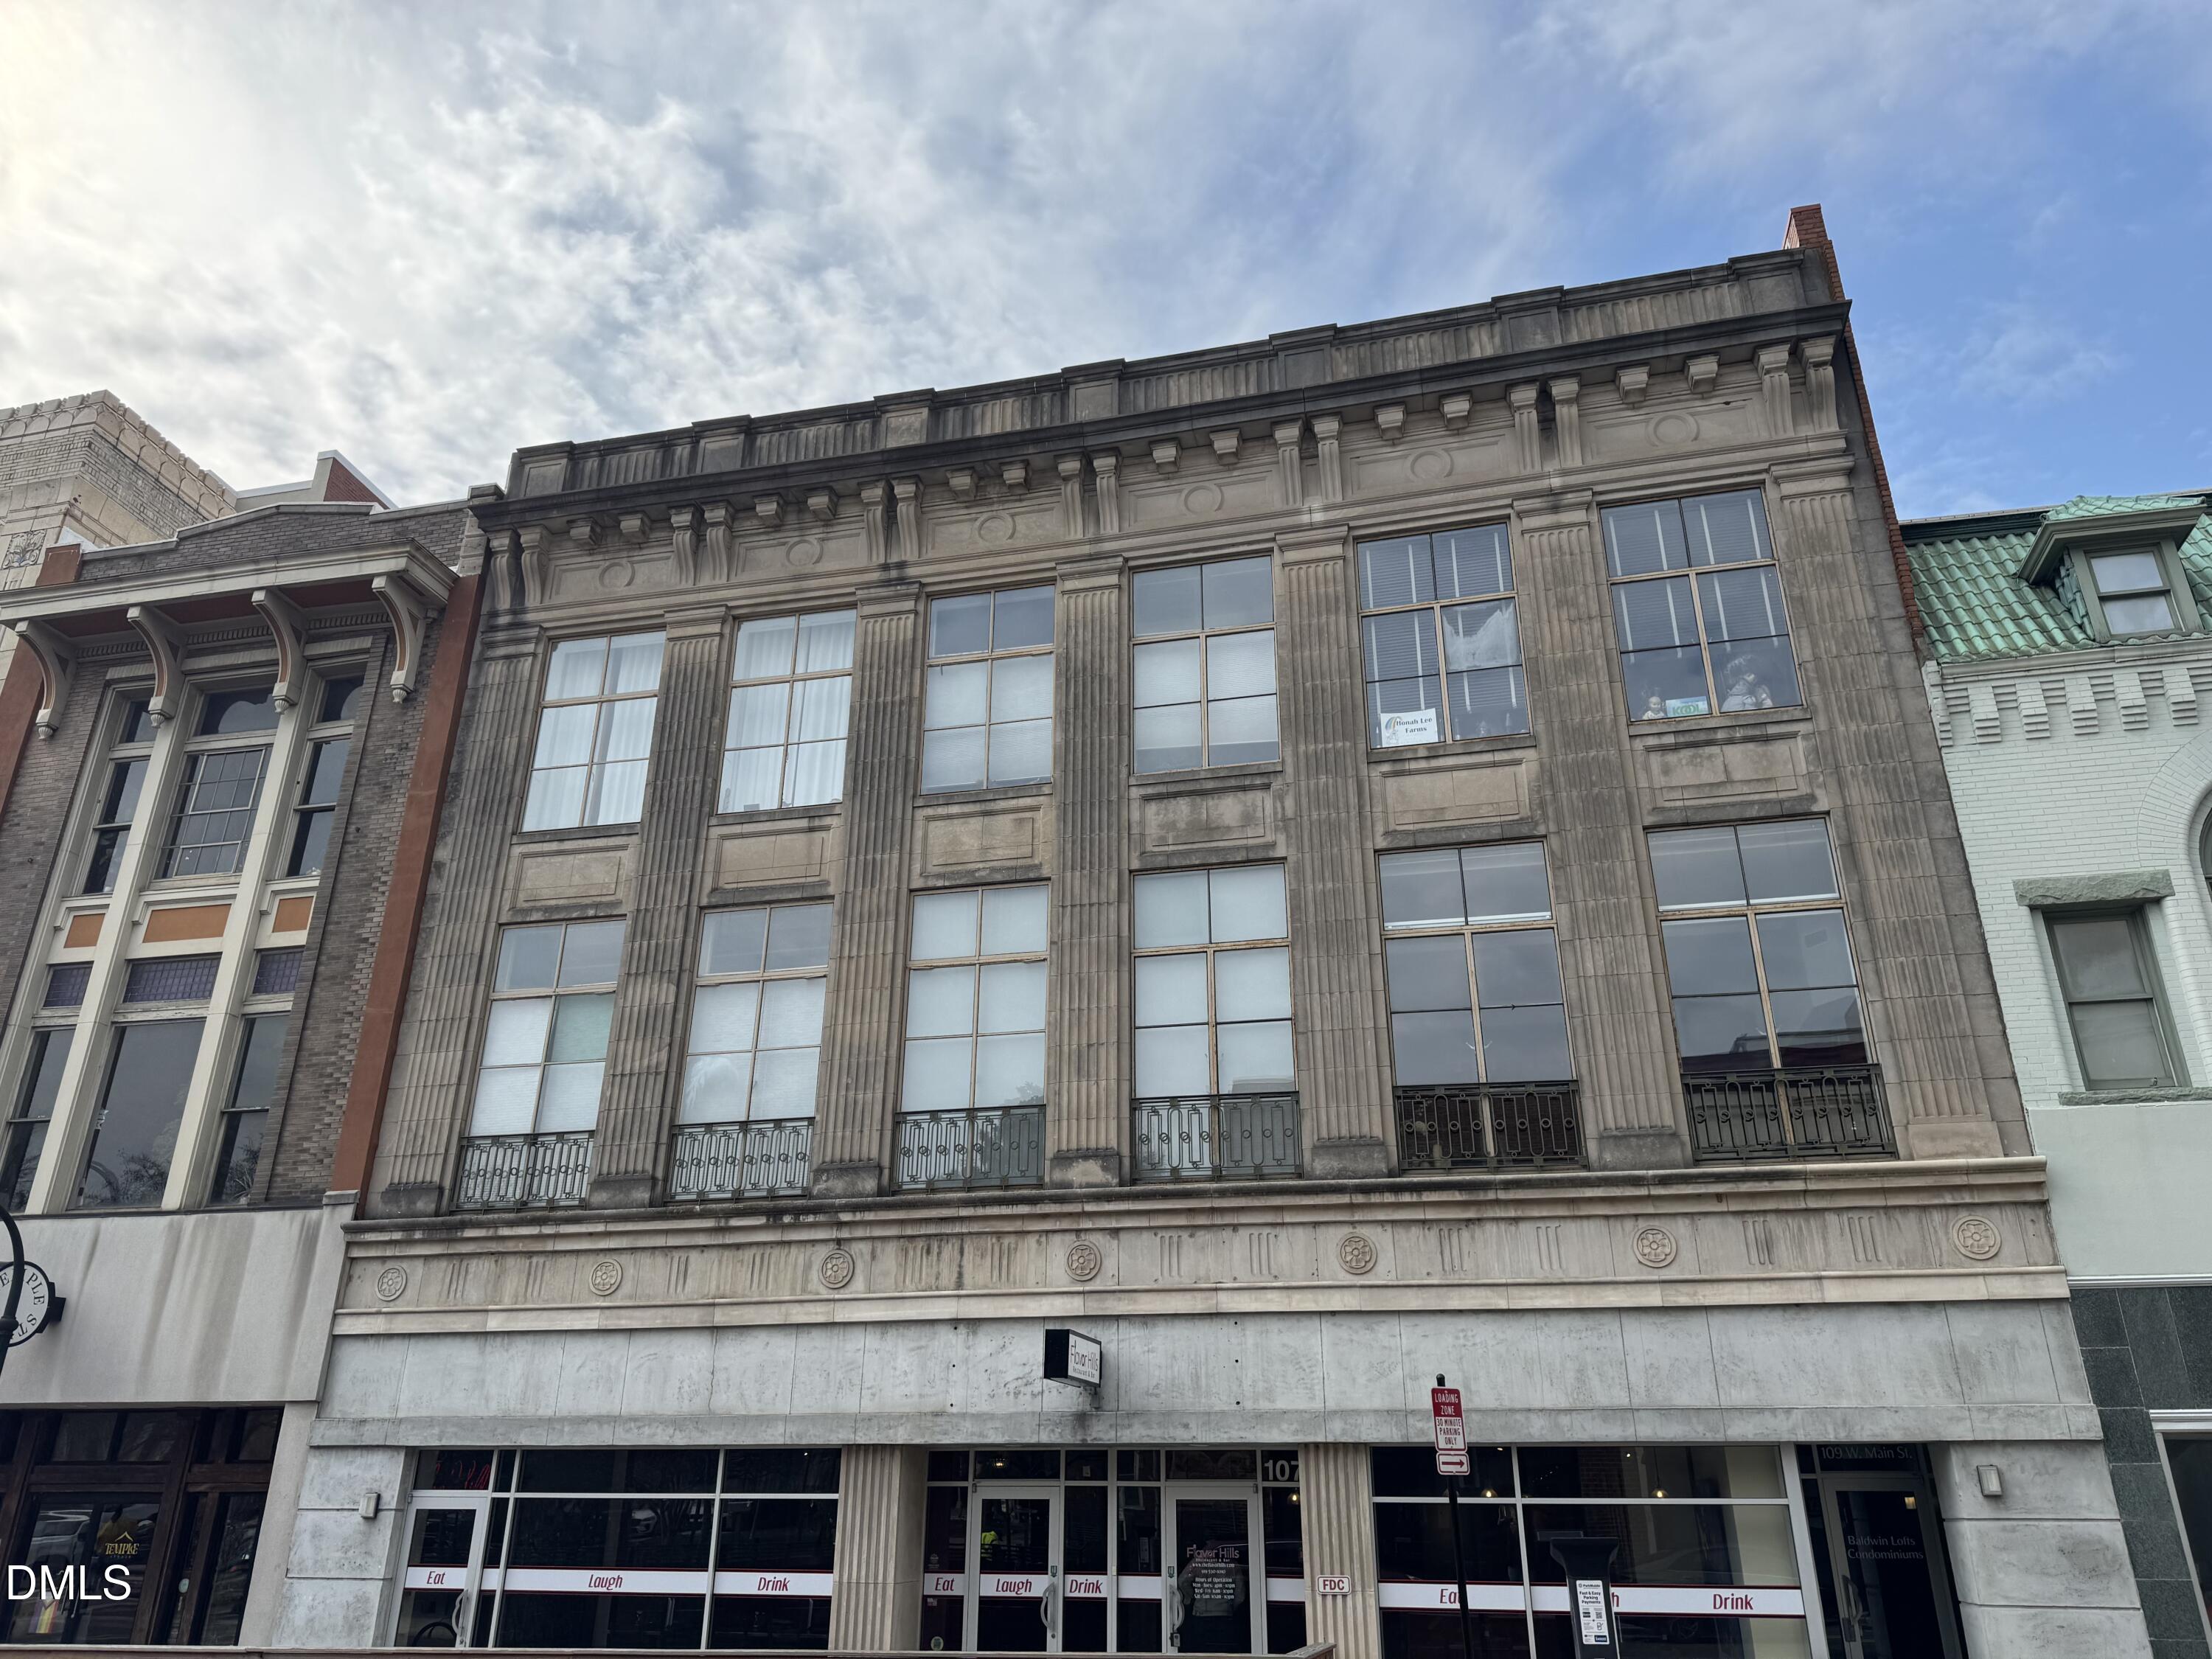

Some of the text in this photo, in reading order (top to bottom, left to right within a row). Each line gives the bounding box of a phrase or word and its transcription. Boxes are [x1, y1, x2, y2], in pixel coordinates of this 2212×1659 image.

[1070, 1339, 1099, 1371] Flavor Hills
[1434, 1393, 1458, 1403] LOADING
[1440, 1405, 1455, 1415] ZONE
[1436, 1418, 1461, 1427] 30 MINUTE
[1439, 1427, 1461, 1436] PARKING
[1444, 1437, 1457, 1445] ONLY
[1821, 1446, 1913, 1459] 109 W. Main St.
[1265, 1459, 1299, 1481] 107
[1848, 1535, 1916, 1545] Baldwin Lofts
[1186, 1544, 1239, 1559] Flavor Hills
[1848, 1549, 1924, 1559] Condominiums
[426, 1571, 790, 1592] Eat Laugh Drink
[935, 1577, 1103, 1595] Eat Laugh Drink
[1323, 1579, 1345, 1590] FDC
[1440, 1588, 1753, 1610] Ea Drink
